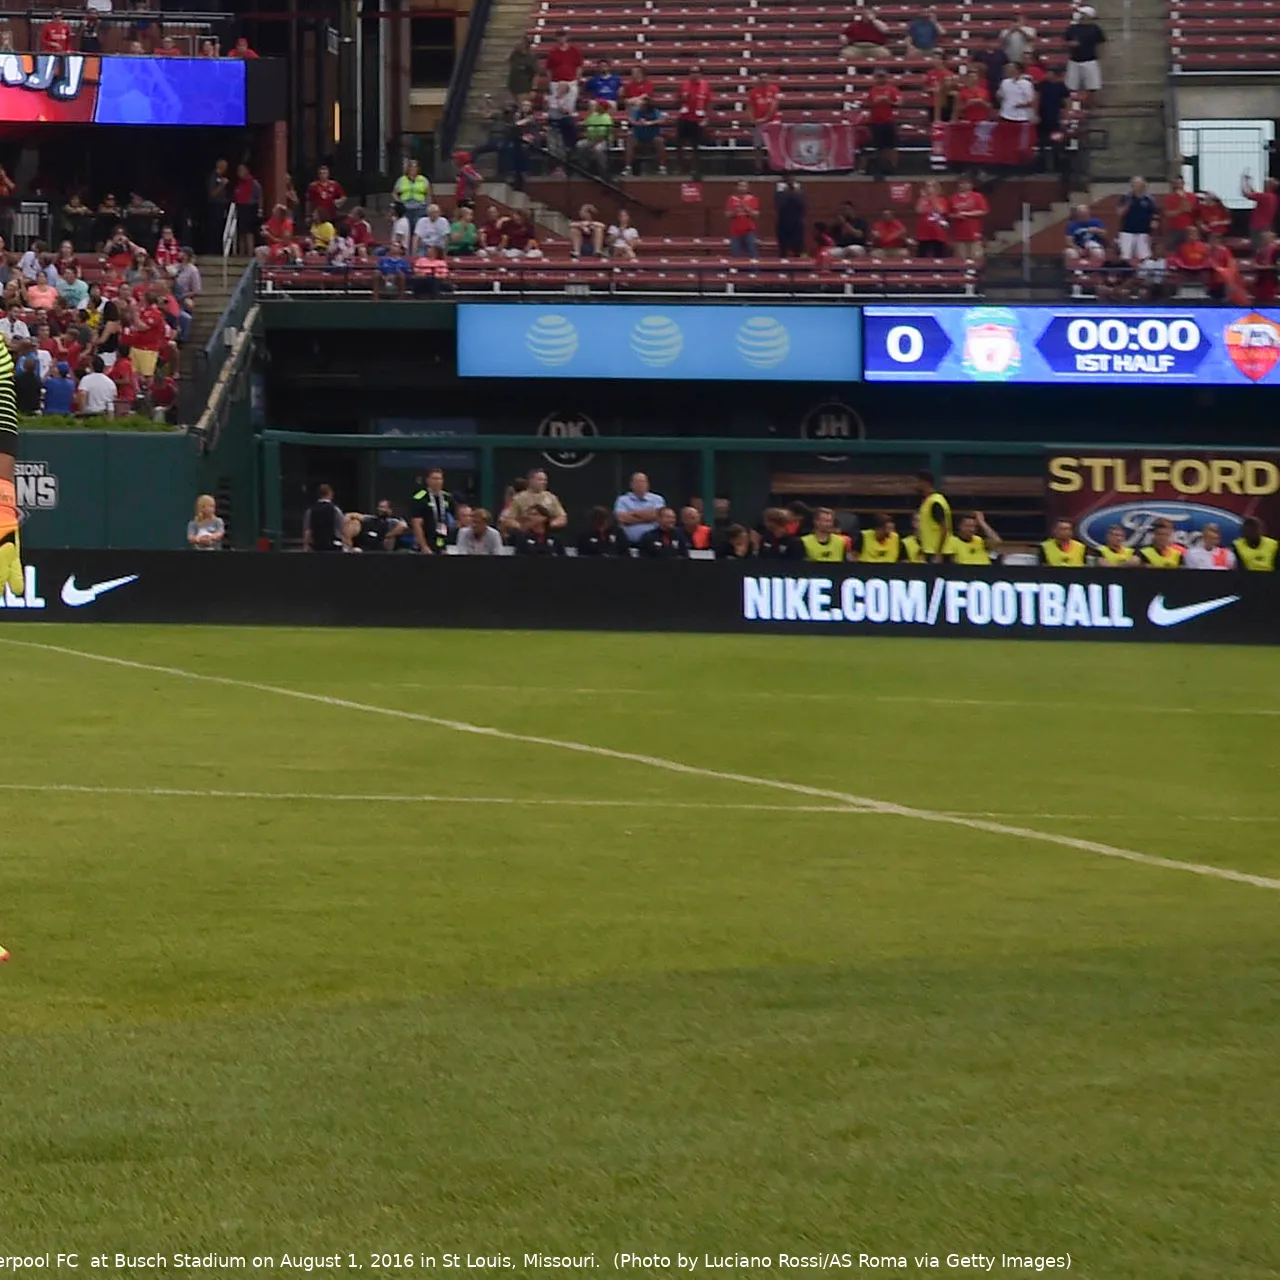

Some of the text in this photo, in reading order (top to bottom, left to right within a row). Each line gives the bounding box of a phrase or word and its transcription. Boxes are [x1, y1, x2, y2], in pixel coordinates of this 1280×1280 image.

[886, 325, 924, 363] 0
[1067, 319, 1201, 351] 00:00
[1075, 354, 1176, 373] 1ST HALF
[1048, 457, 1280, 496] STLFORD
[743, 576, 1134, 627] NIKE.COM/FOOTBALL
